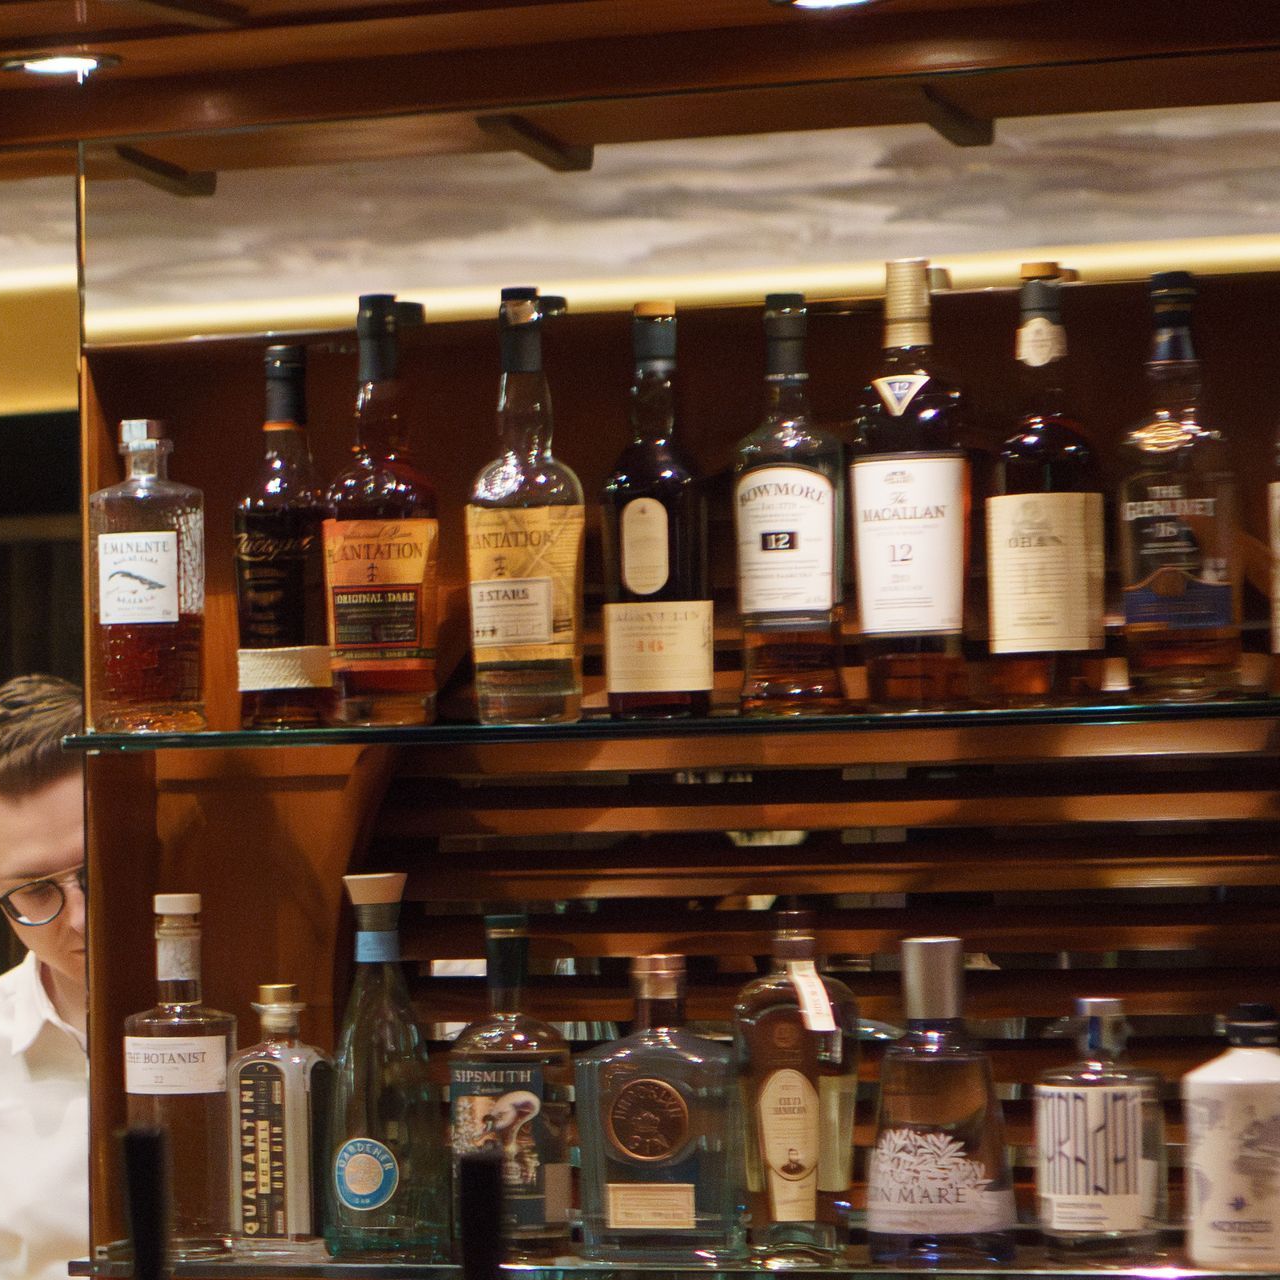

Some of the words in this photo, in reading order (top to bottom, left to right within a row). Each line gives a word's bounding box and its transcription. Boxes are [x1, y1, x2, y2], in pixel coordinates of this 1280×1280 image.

[863, 505, 947, 523] MACALLAN
[103, 541, 171, 555] EMINENTE
[767, 533, 791, 549] 12
[887, 544, 913, 562] 12
[335, 593, 383, 605] ORIGINAL
[143, 1051, 207, 1065] BOTANIST
[455, 1069, 532, 1083] SIPSMITH
[241, 1079, 259, 1236] QUARANTINI
